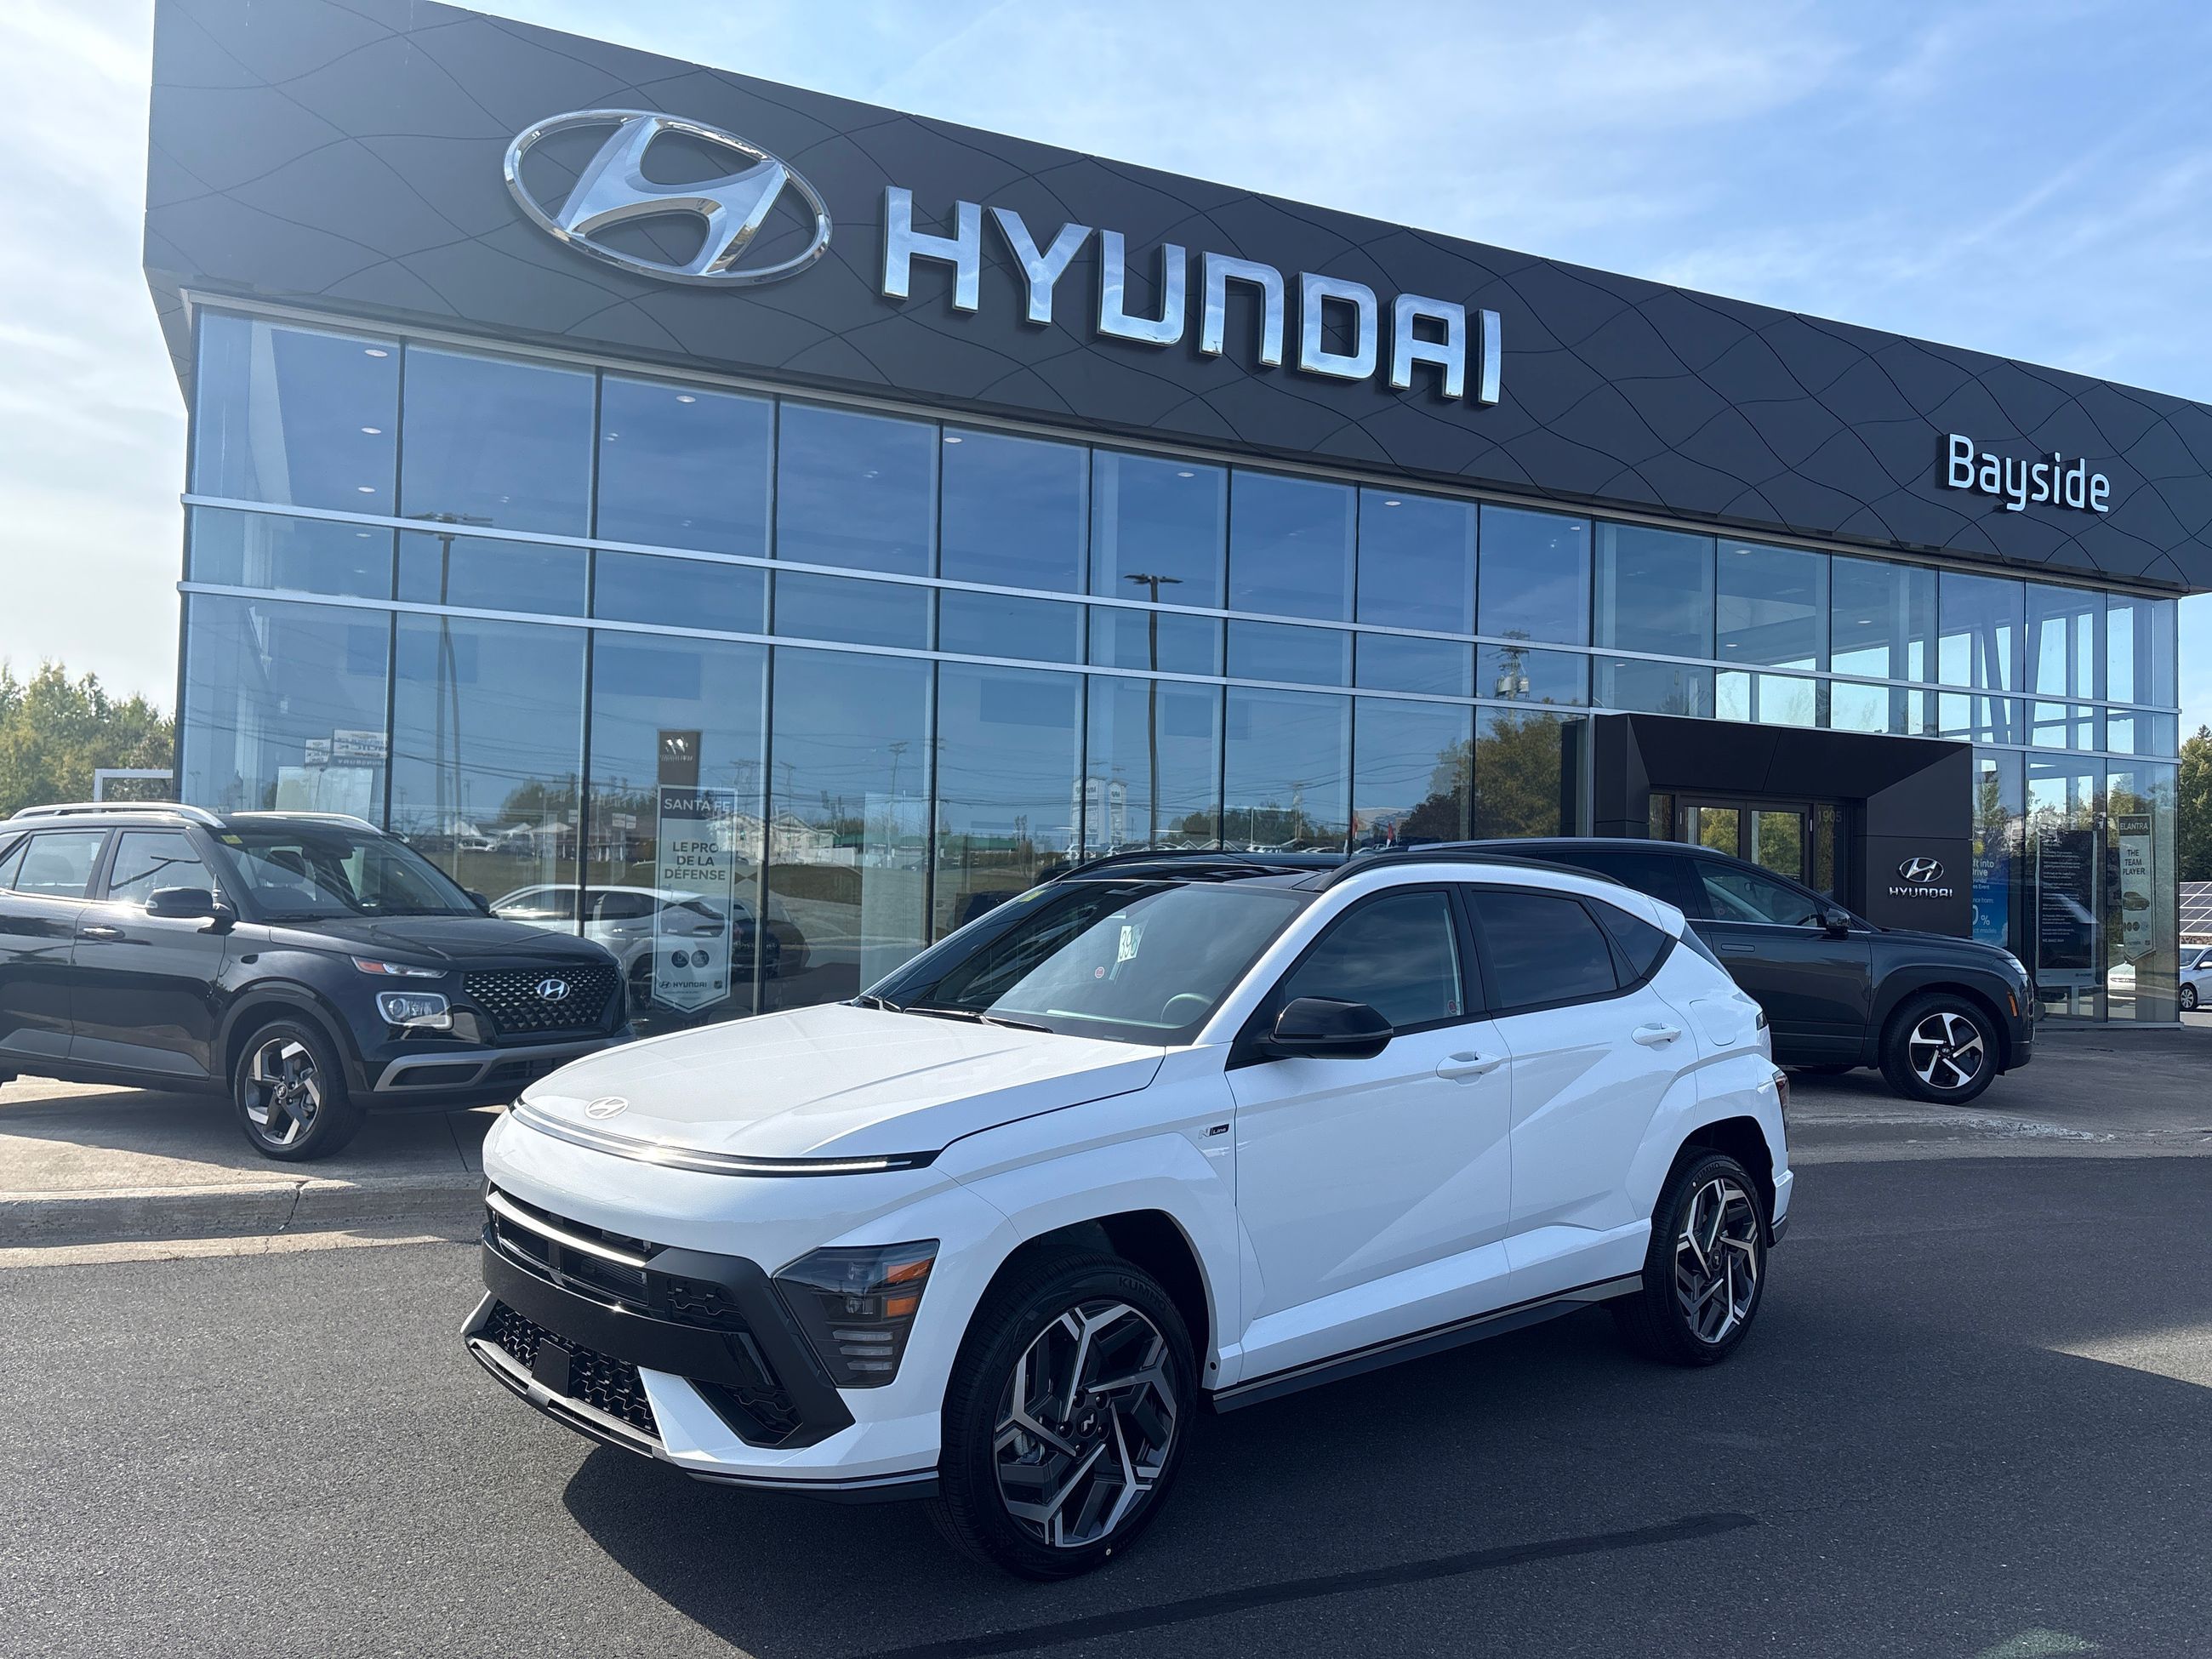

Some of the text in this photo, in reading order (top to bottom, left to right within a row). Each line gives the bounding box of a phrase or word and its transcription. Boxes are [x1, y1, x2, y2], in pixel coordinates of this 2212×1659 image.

[881, 185, 1501, 405] HYUNDAI
[1947, 433, 2111, 512] Bayside
[664, 798, 732, 812] SANTA FE
[1817, 809, 1842, 823] 1905
[2119, 822, 2149, 830] ELANTRA
[672, 841, 719, 853] LE PRO
[676, 855, 715, 866] DE LA
[664, 866, 727, 881] DÉFENSE
[2123, 867, 2146, 875] PLAYER
[1889, 887, 1953, 898] HYUNDAI
